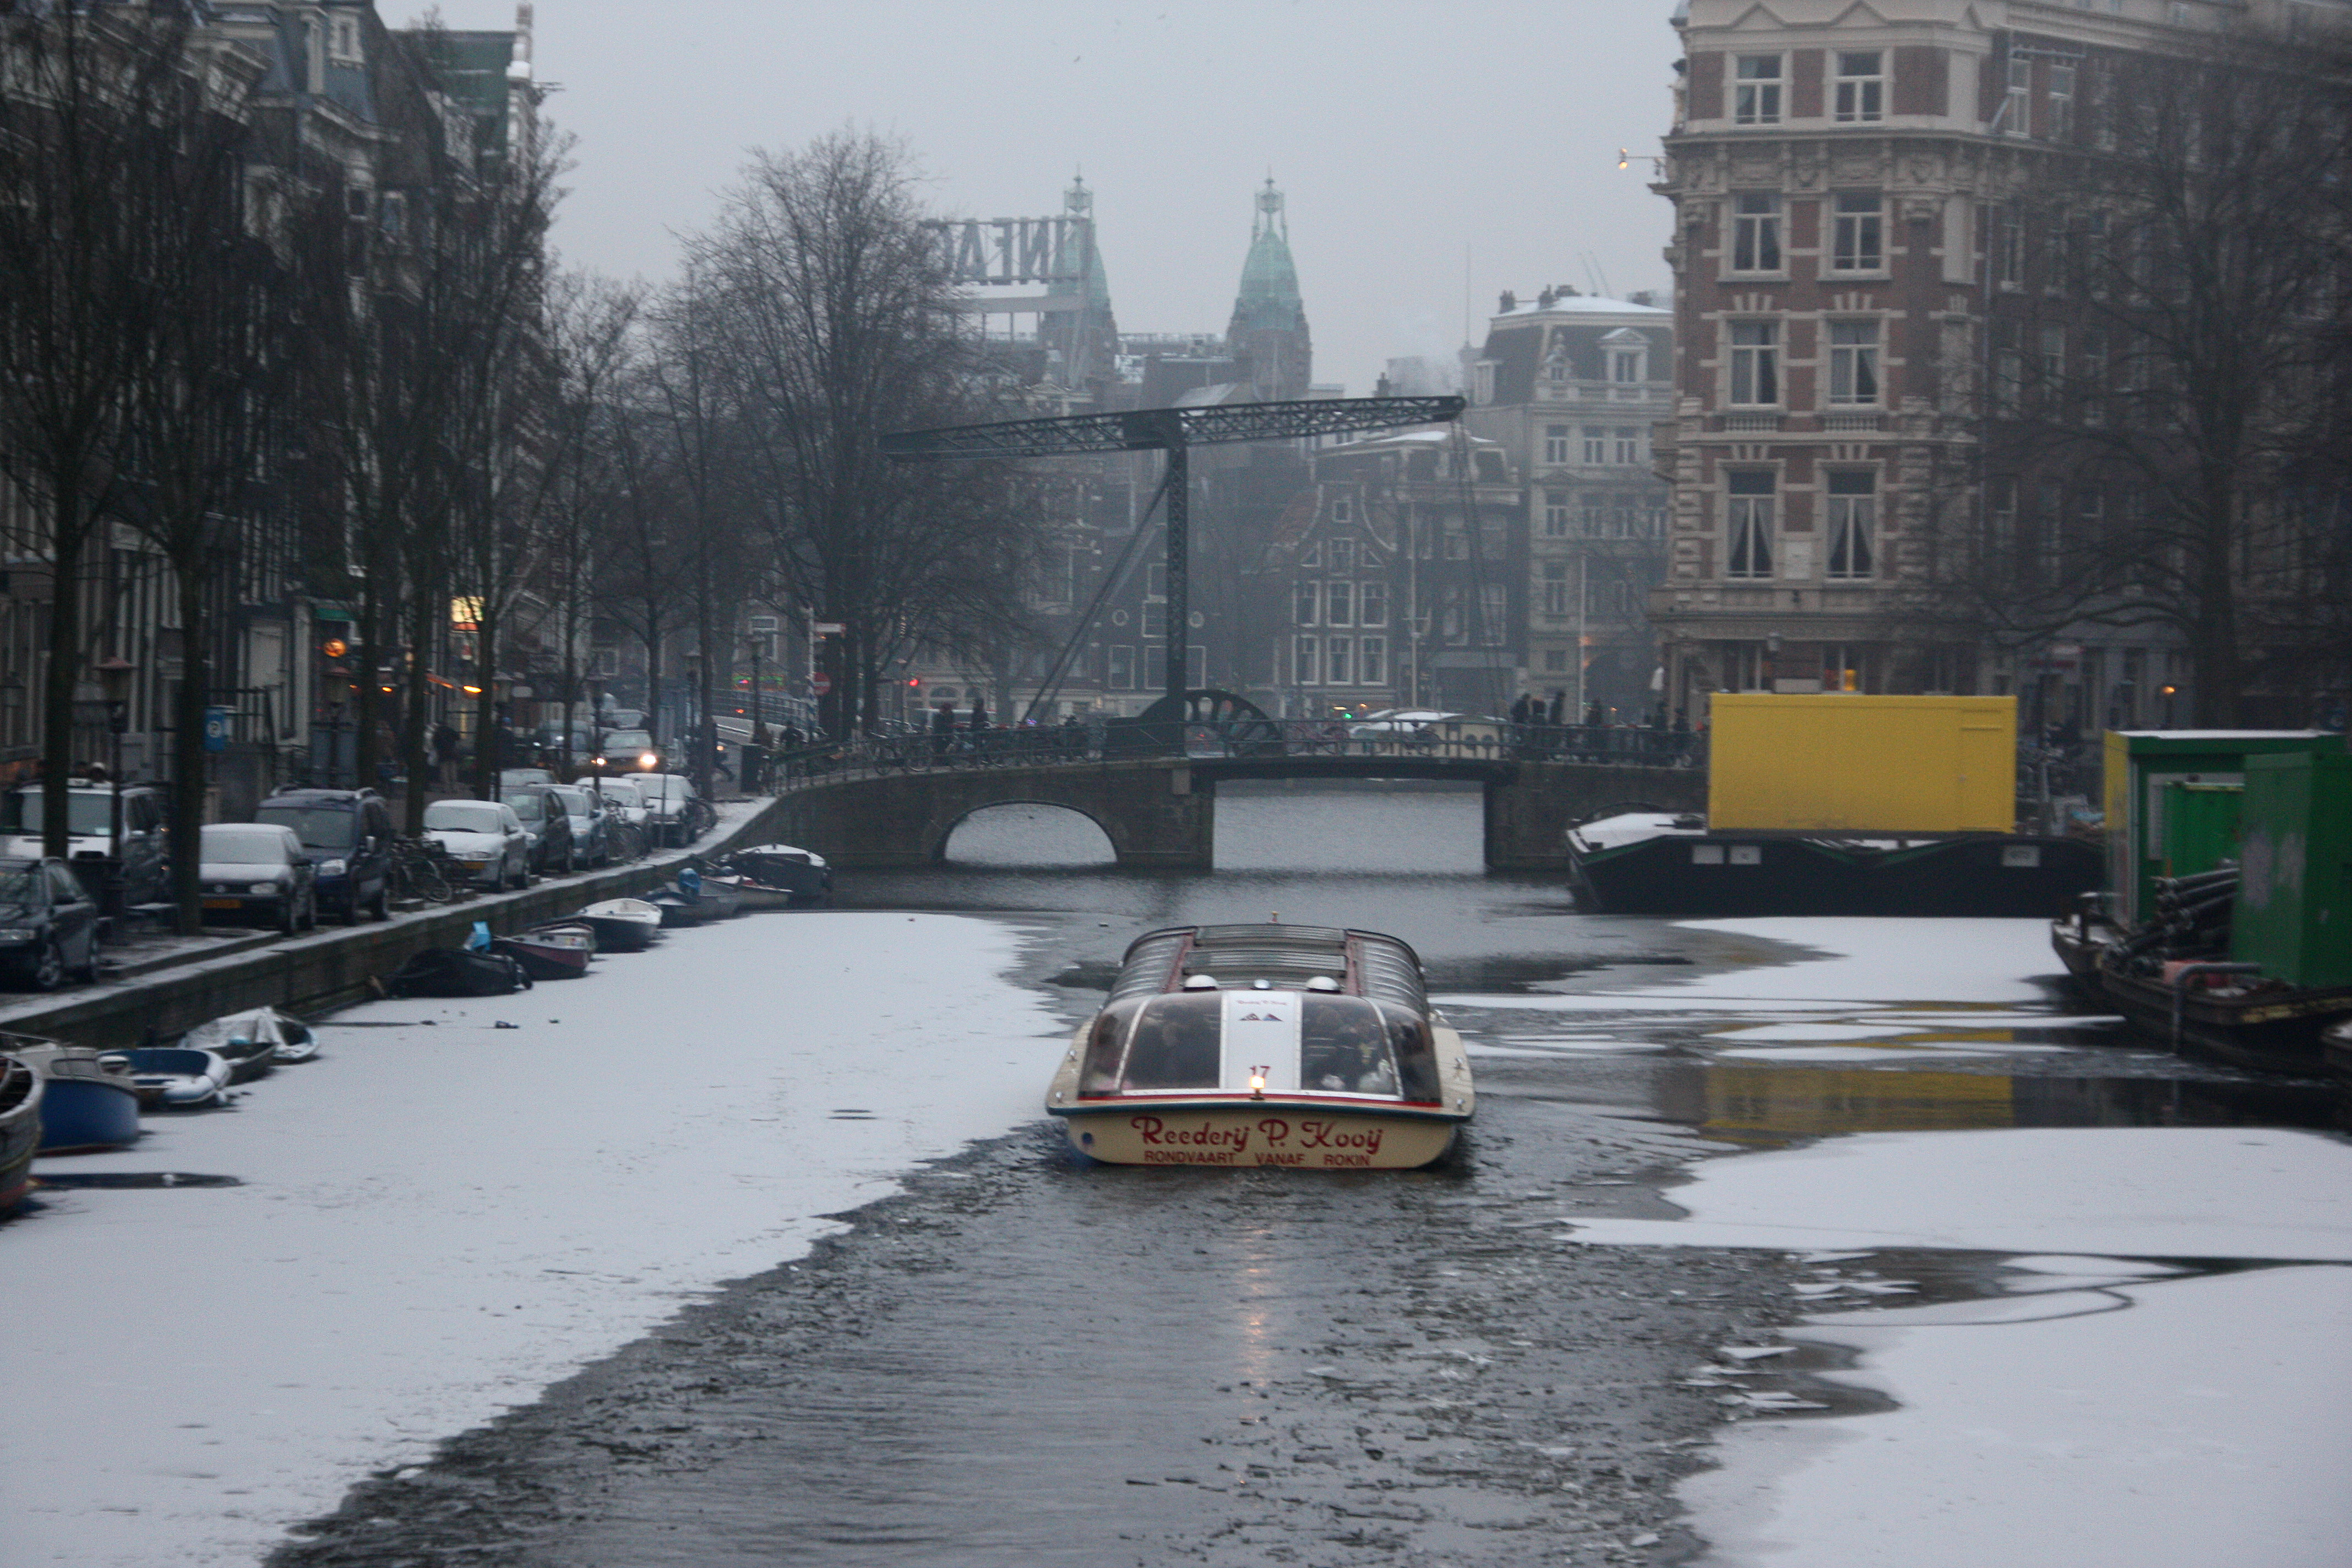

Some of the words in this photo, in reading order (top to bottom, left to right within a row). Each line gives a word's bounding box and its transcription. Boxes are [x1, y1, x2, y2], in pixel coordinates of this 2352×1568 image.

[1131, 1116, 1250, 1153] Reederij
[1257, 1118, 1289, 1148] P.
[1300, 1120, 1384, 1155] Kooij
[1144, 1150, 1236, 1164] RONDVAART
[1255, 1152, 1305, 1166] VANAF
[1324, 1154, 1371, 1167] ROKIN
